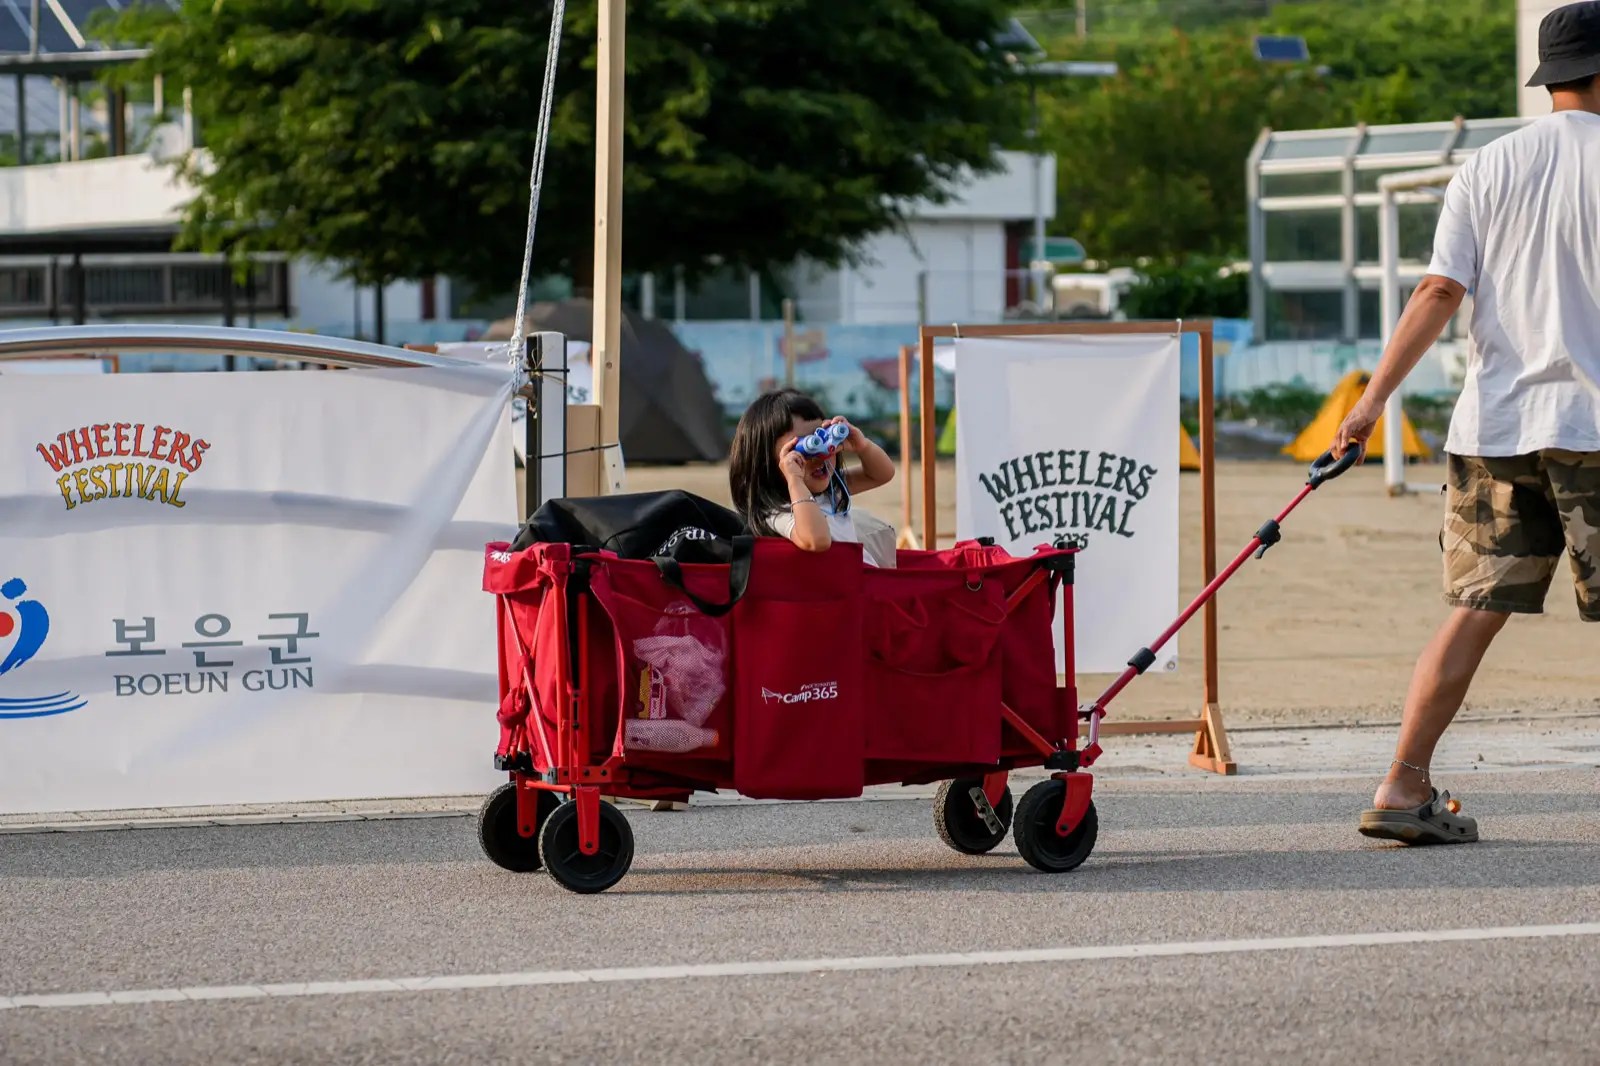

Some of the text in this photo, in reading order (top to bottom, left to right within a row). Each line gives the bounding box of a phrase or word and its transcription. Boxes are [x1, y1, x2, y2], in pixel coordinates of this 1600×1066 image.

[36, 422, 211, 472] WHEELERS
[56, 462, 188, 510] FESTIVAL
[979, 449, 1158, 503] WHEELERS
[999, 490, 1137, 541] FESTIVAL
[105, 612, 320, 668] 보은군
[113, 667, 314, 697] BOEUN GUN
[783, 686, 838, 703] Camp365
